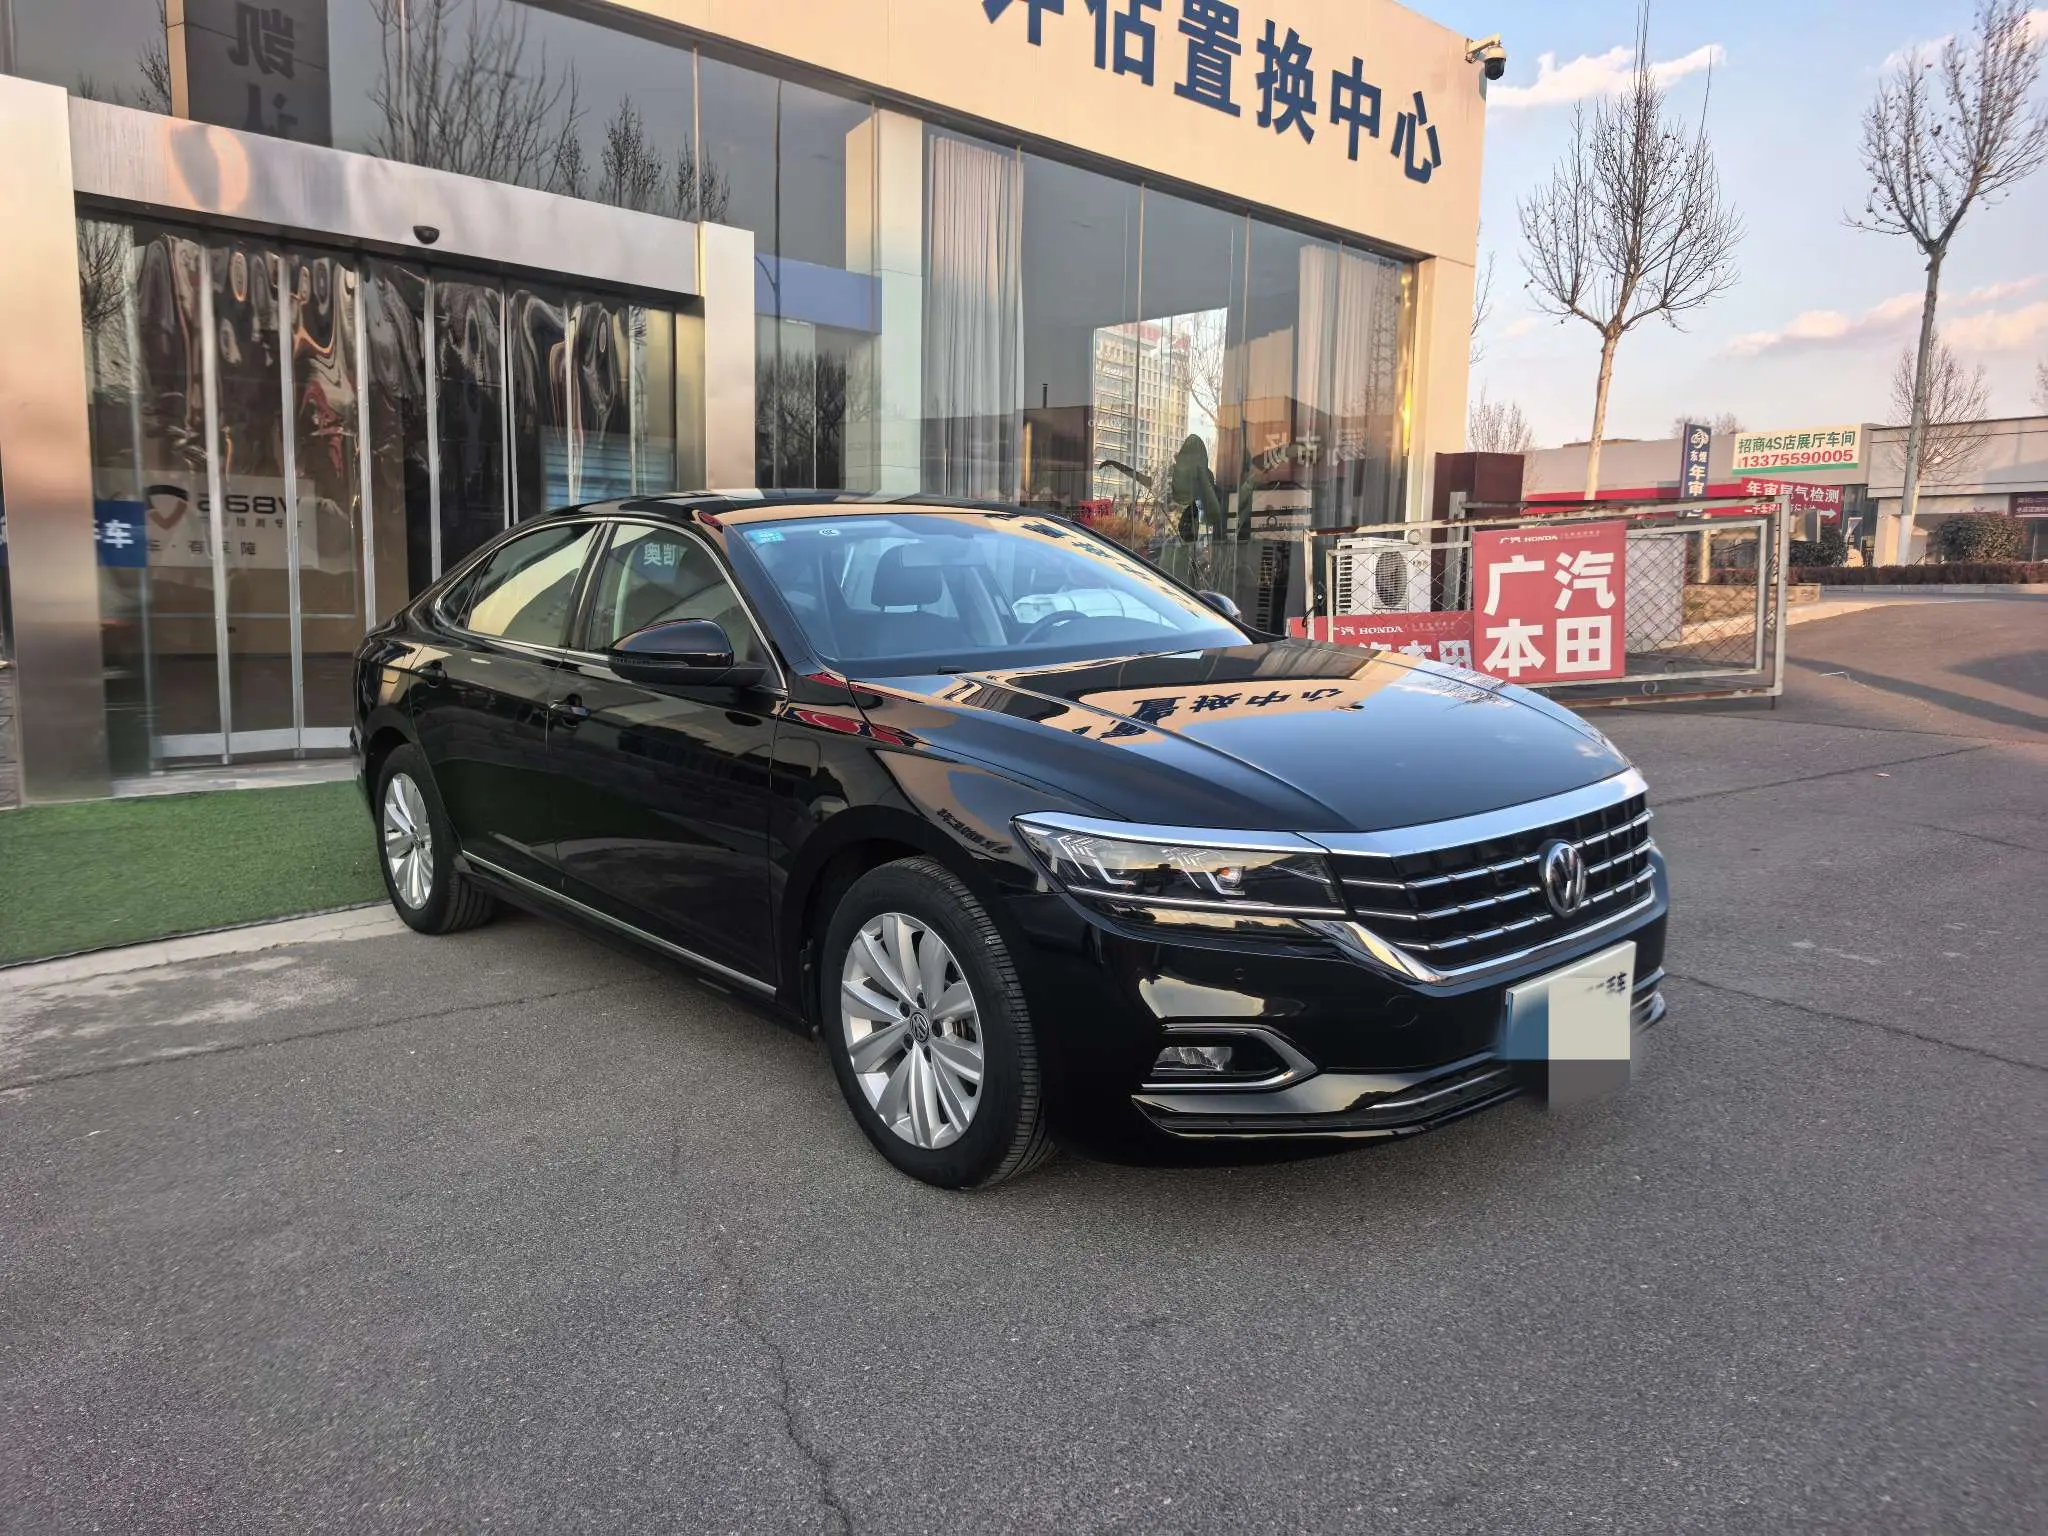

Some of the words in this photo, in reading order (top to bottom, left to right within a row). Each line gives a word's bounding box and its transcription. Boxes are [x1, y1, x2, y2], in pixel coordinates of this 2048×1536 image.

[1738, 430, 1856, 454] 招商4S店展厅车间
[1742, 450, 1853, 468] 13375590005
[1524, 535, 1558, 543] HONDA
[643, 542, 677, 567] 奥凯
[1483, 551, 1616, 616] 广汽
[1359, 626, 1404, 636] HONDA
[1482, 615, 1613, 678] 本田
